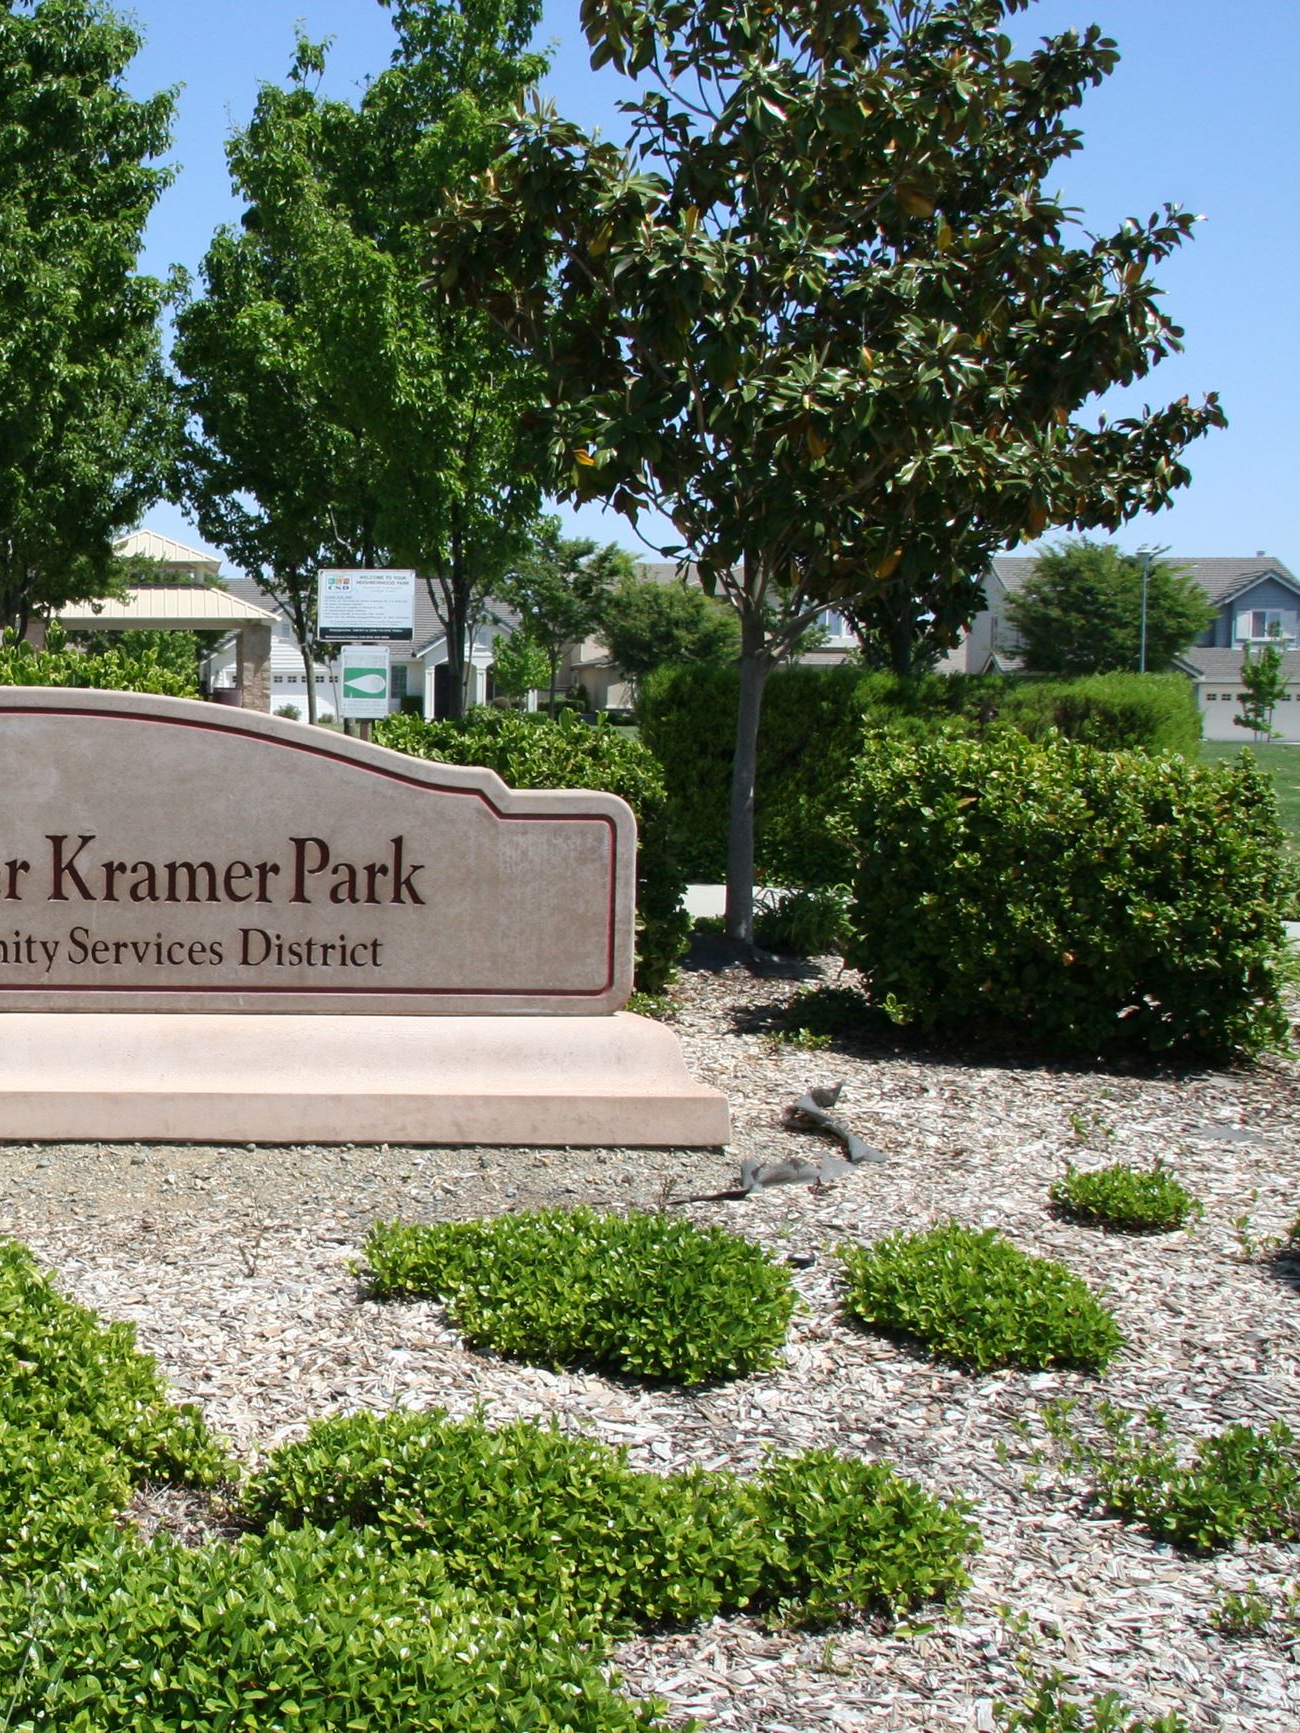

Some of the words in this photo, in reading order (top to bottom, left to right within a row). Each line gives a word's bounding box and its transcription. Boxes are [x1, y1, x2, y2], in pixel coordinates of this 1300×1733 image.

[45, 834, 281, 904] Kramer
[289, 835, 427, 906] Park
[68, 926, 224, 966] Services
[239, 927, 384, 968] District
